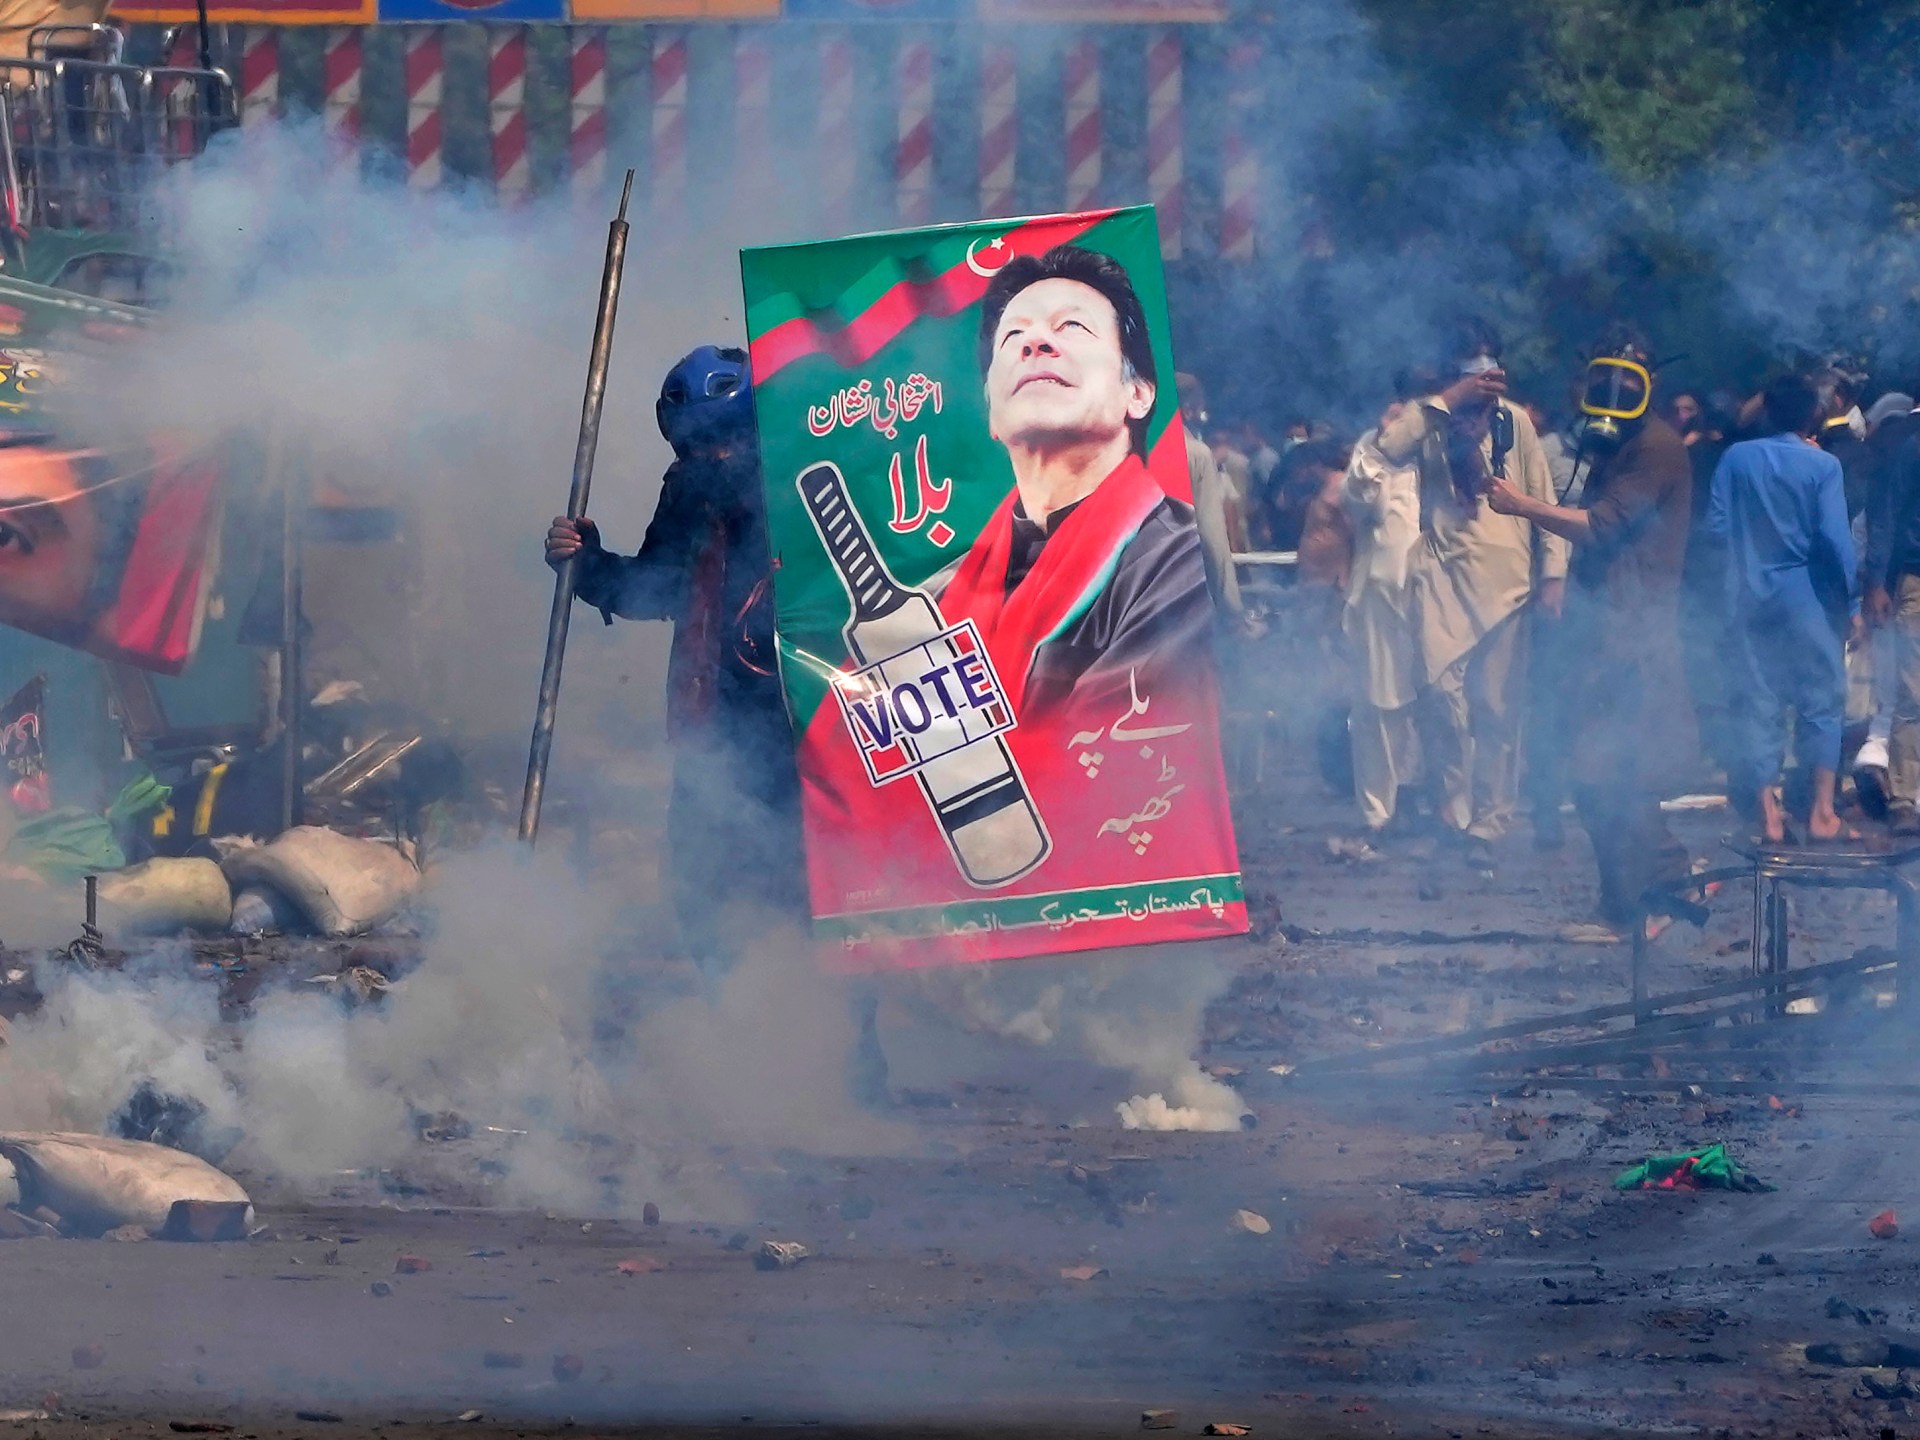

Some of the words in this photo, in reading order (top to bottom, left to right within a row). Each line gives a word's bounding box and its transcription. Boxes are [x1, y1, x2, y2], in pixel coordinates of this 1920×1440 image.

[808, 379, 872, 437] نشان
[871, 373, 943, 440] انتخابی
[888, 434, 955, 547] بلا
[852, 654, 995, 748] VOTE
[1109, 666, 1192, 760] بلے
[1067, 726, 1105, 779] پہ
[1127, 888, 1224, 920] پاکستان
